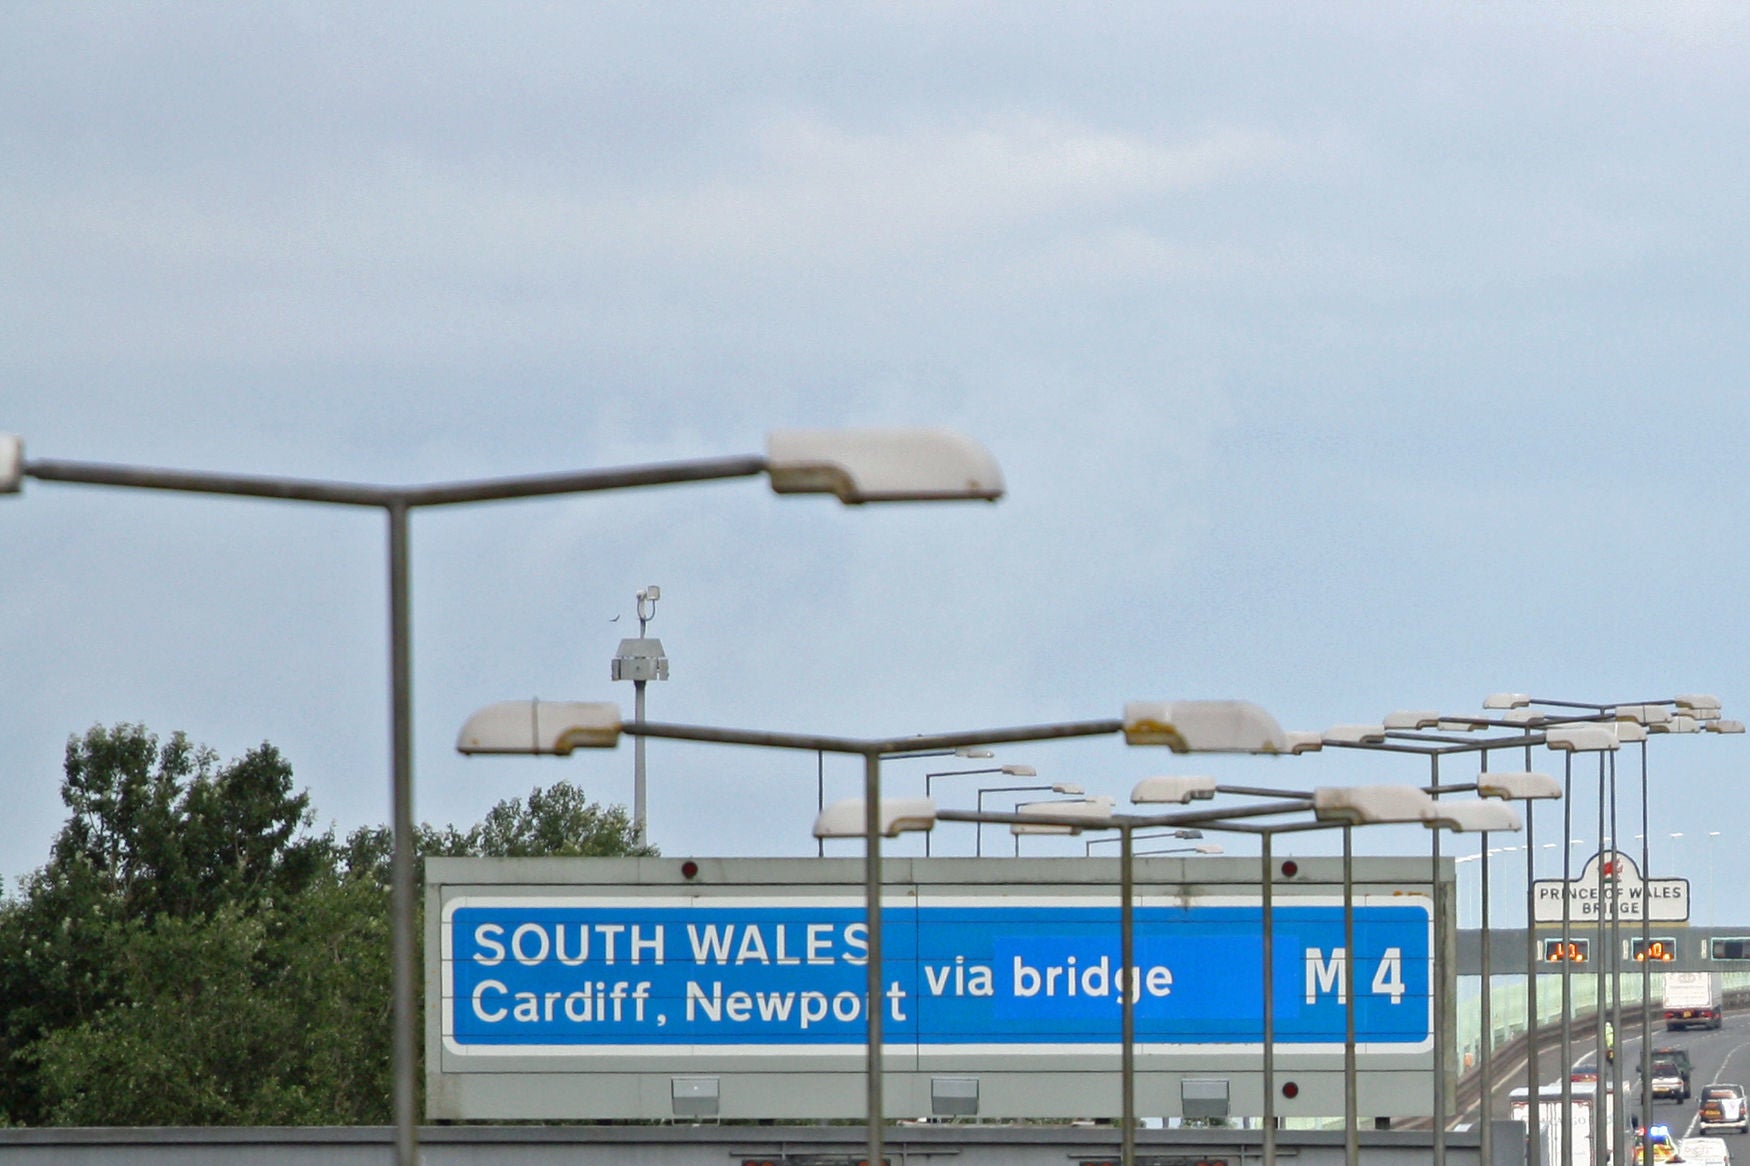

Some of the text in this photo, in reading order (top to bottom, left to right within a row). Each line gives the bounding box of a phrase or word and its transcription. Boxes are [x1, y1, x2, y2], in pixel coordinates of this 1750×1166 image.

[1540, 887, 1598, 900] PRINCE
[1582, 902, 1639, 914] BRIGE
[472, 922, 870, 966] SOUTH WALES
[924, 955, 1174, 1005] via bridge
[1305, 946, 1407, 1006] M 4
[472, 978, 668, 1028] Cardiff,
